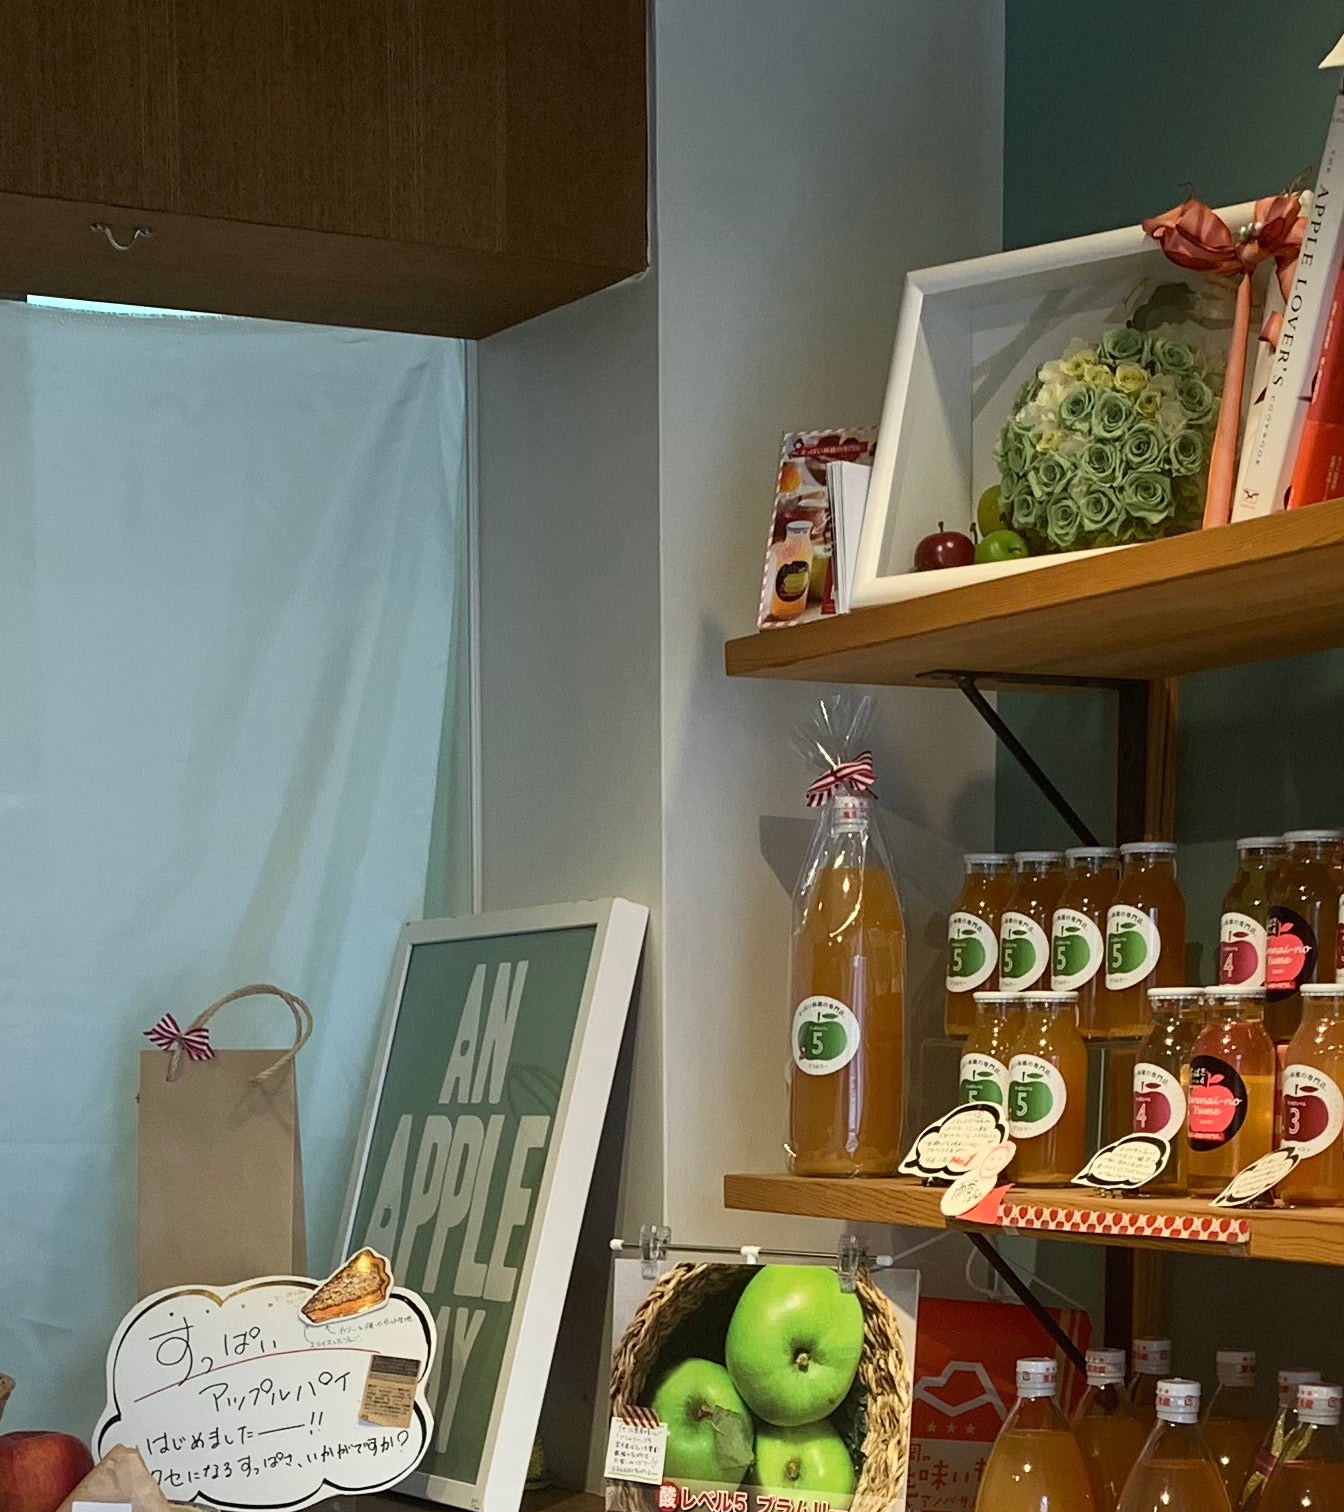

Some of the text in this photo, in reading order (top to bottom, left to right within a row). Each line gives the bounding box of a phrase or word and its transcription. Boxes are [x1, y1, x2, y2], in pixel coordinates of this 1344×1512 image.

[1301, 184, 1331, 268] APPLE
[1272, 278, 1305, 388] LOVER'S
[1222, 952, 1234, 978] 4
[437, 959, 529, 1105] AN
[811, 1031, 824, 1055] 5
[1015, 1092, 1029, 1117] 5
[1135, 1102, 1148, 1129] 4
[1288, 1107, 1301, 1135] 3
[364, 1113, 551, 1303] APPLE
[147, 1316, 279, 1387] すっぱい
[198, 1370, 352, 1413] アップルパイ
